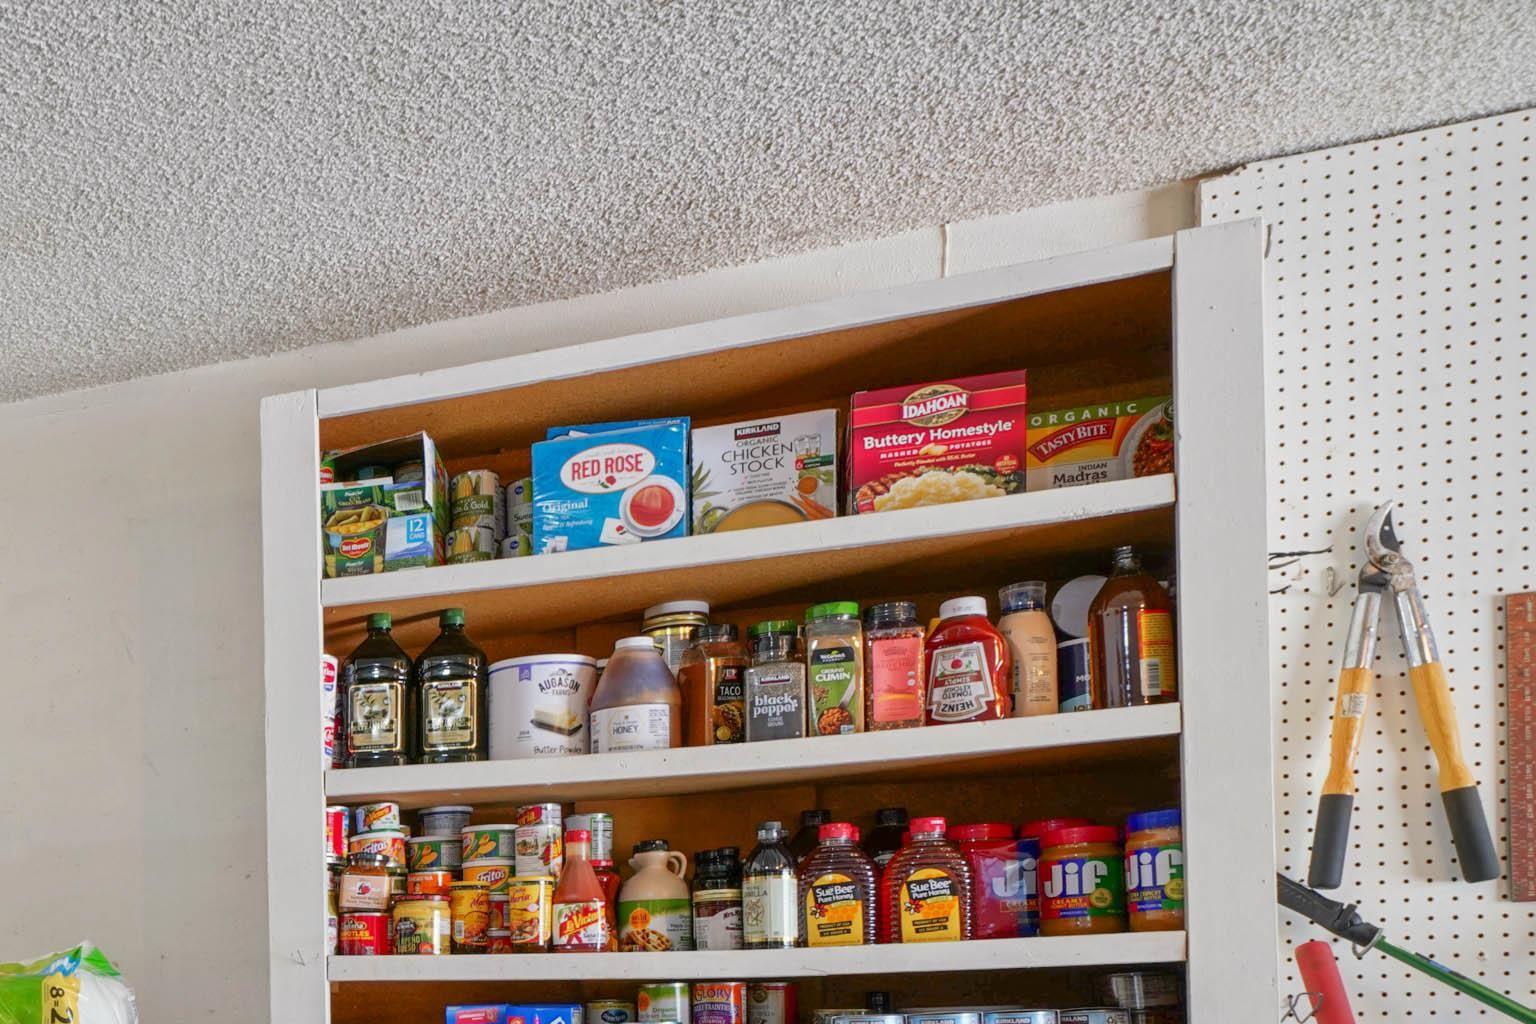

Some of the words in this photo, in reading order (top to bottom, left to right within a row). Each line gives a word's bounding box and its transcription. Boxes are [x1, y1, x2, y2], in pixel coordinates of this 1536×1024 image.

[902, 394, 968, 419] IDAHOAN
[1030, 403, 1137, 427] ORGANIC
[736, 424, 780, 436] KIRKLAND
[863, 431, 926, 450] Buttery
[929, 419, 1012, 442] Homestyle
[736, 436, 779, 448] ORGANIC
[1037, 430, 1076, 456] TASTY
[1076, 424, 1109, 440] BITE
[721, 442, 794, 464] CHICKEN
[880, 449, 919, 460] MASHED
[949, 439, 992, 450] POTATOES
[571, 459, 601, 481] RED
[604, 452, 644, 474] ROSE
[730, 457, 785, 476] STOCK
[1078, 462, 1108, 471] INDIAN
[1053, 470, 1108, 485] Madras
[542, 498, 589, 514] Original
[409, 518, 425, 532] 12
[760, 674, 791, 683] KIRKLAND
[815, 672, 850, 682] CUMIN
[538, 679, 581, 694] AUGASON
[720, 686, 741, 696] TACO
[754, 693, 793, 706] black
[942, 690, 973, 700] TOMATO
[753, 701, 798, 718] pepper
[941, 700, 975, 713] HEINZ
[613, 724, 639, 736] HONEY
[476, 869, 505, 884] Fritos
[1125, 849, 1182, 890] Jif
[909, 881, 929, 892] Sue
[929, 878, 951, 890] Bee
[1044, 860, 1108, 898] Jif
[927, 887, 950, 898] Honey
